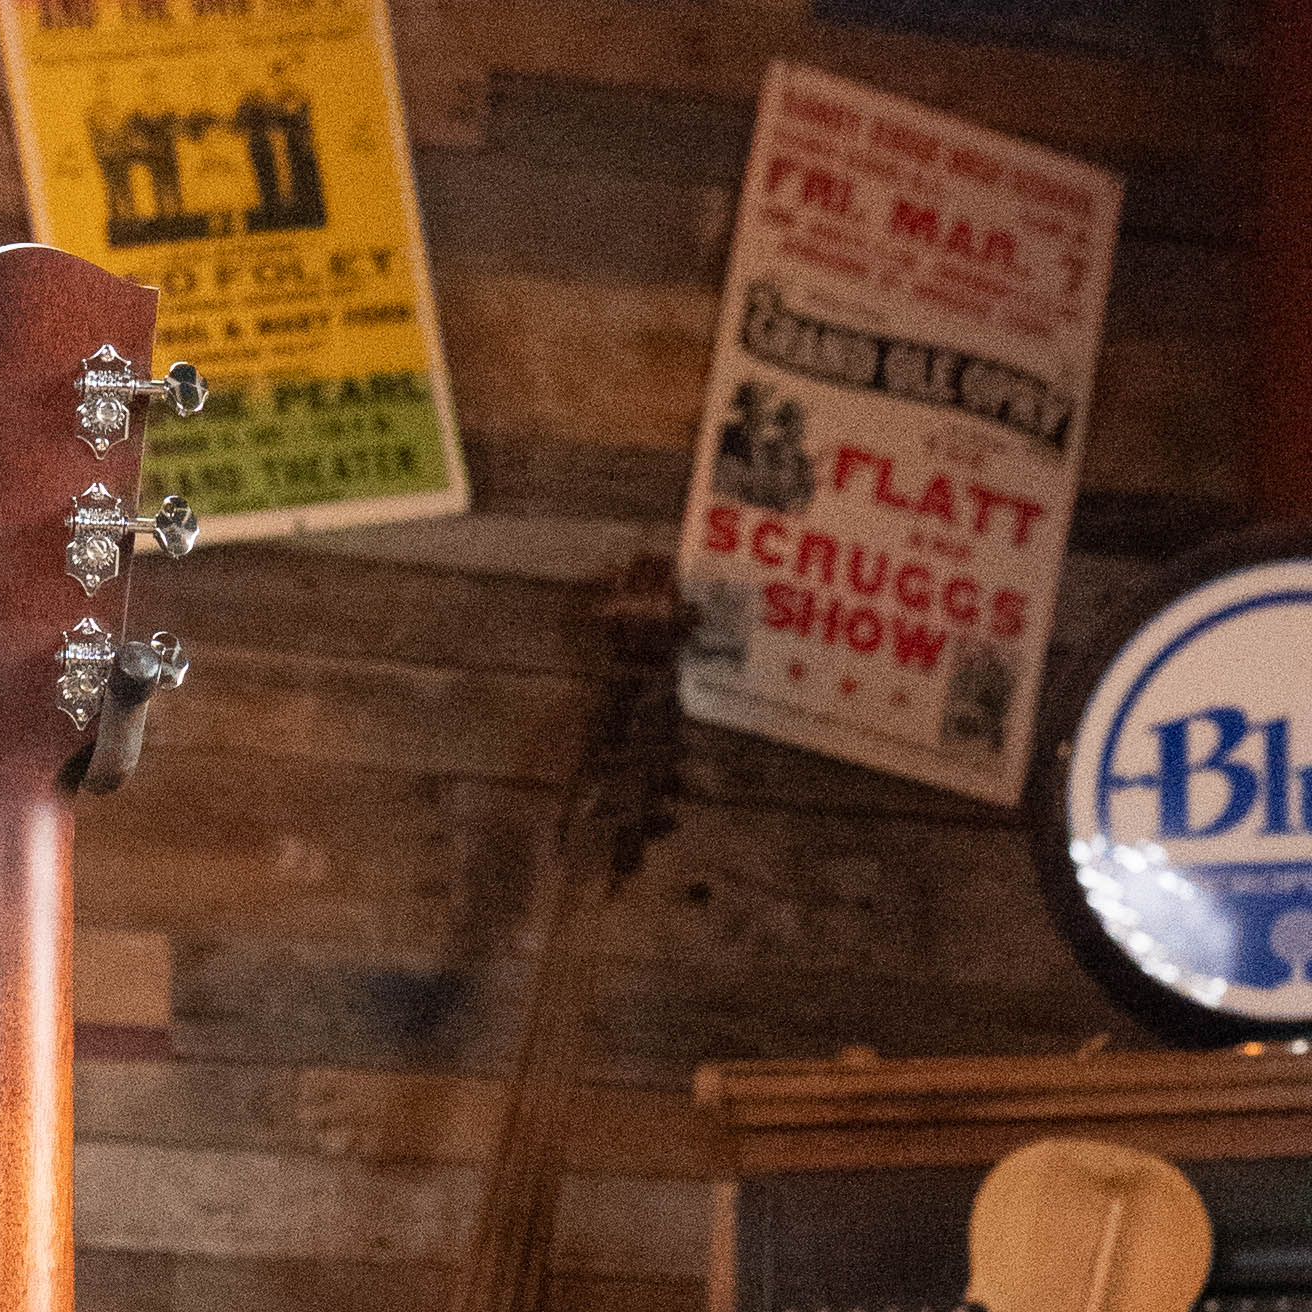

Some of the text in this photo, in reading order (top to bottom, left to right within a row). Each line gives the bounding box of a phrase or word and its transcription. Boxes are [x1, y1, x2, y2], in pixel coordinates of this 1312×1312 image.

[831, 445, 1047, 548] FLATT
[704, 506, 1028, 639] SCRUGGS
[762, 581, 949, 672] SHOW
[1150, 705, 1312, 840] Bl
